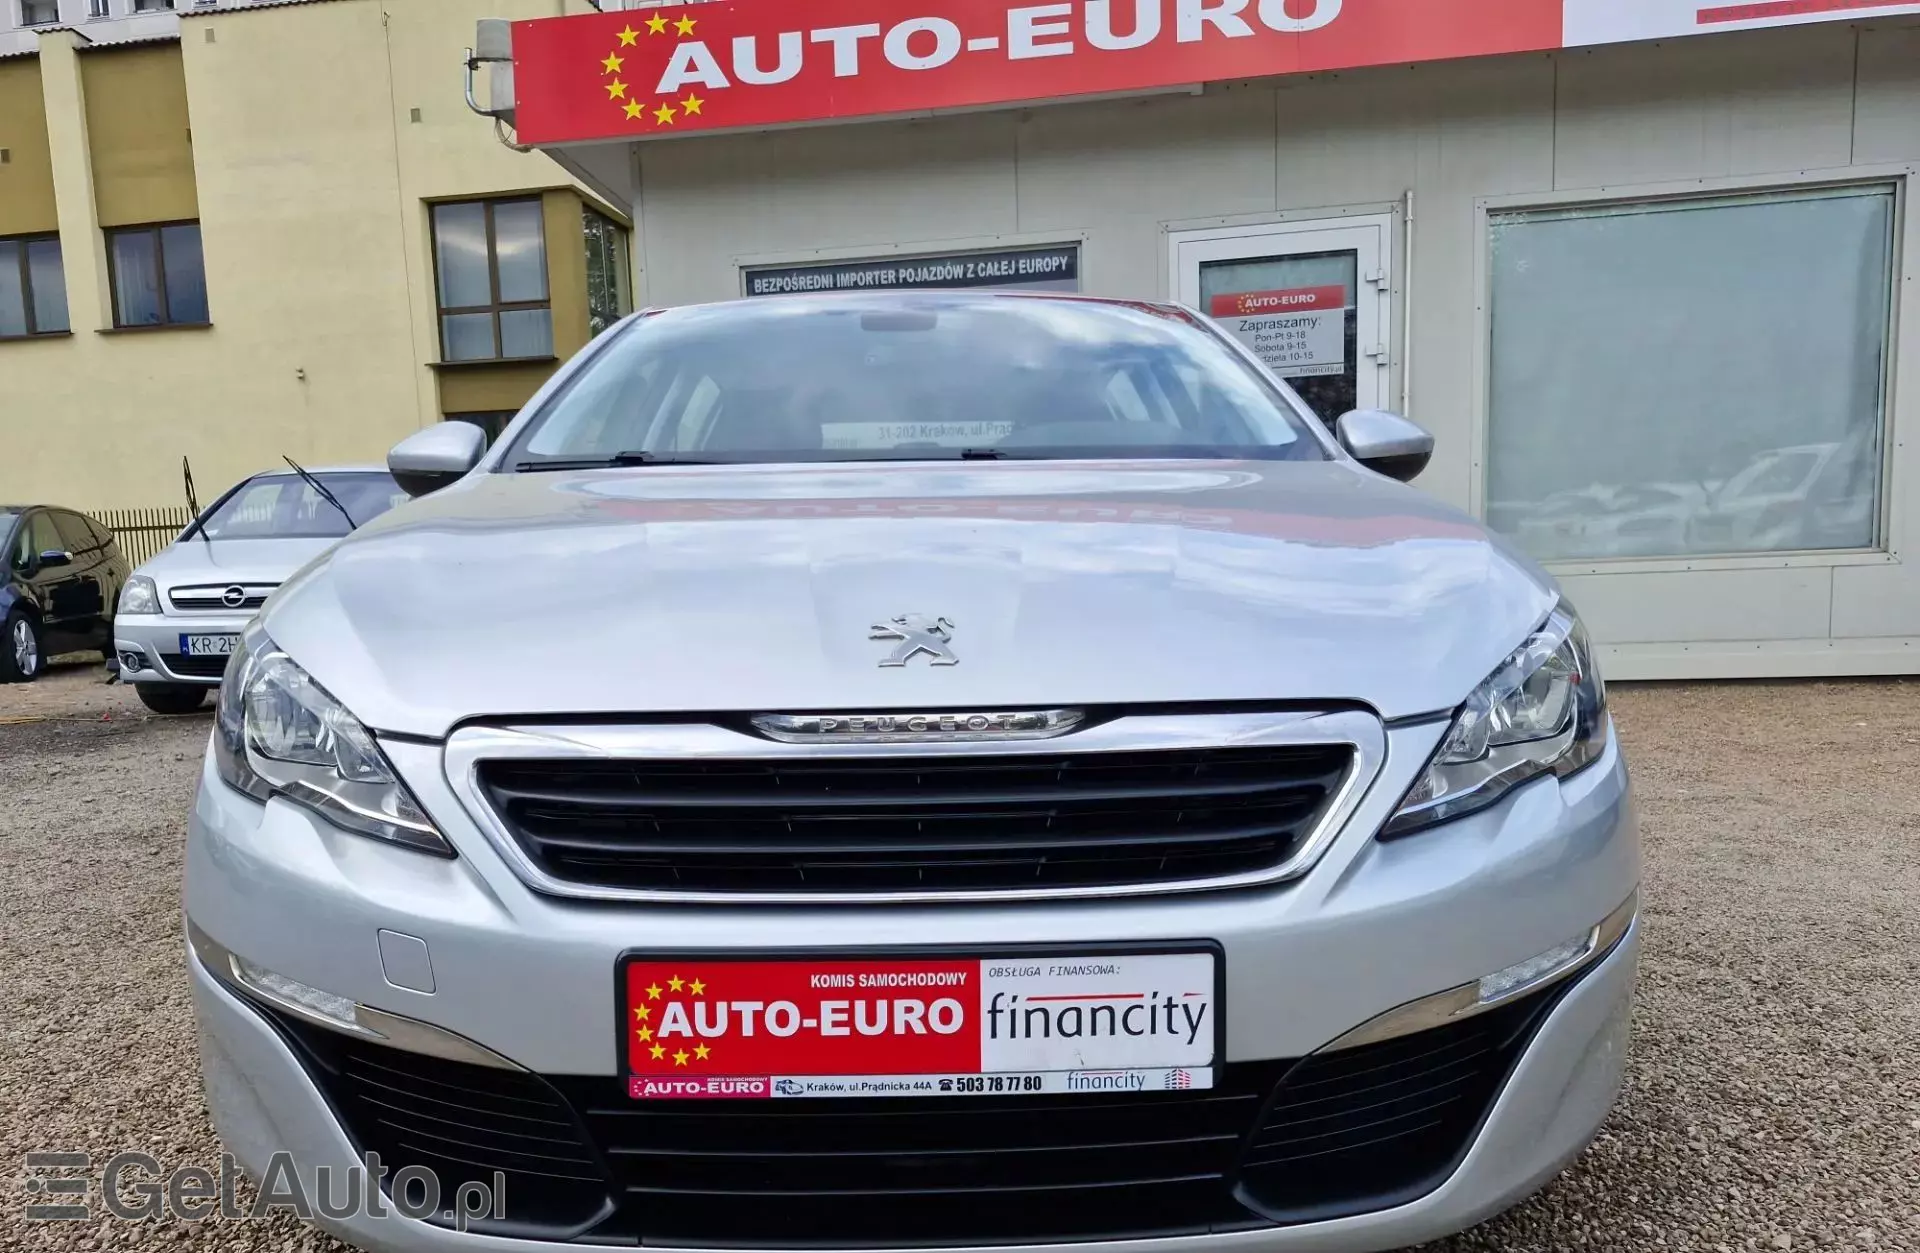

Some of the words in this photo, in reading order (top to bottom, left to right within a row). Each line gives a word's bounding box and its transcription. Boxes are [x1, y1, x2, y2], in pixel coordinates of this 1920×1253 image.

[655, 0, 1342, 94] AUTO-EURO
[754, 272, 833, 293] BEZPOŚREDNI
[836, 269, 896, 288] IMPORTER
[898, 262, 964, 284] POJAZDÓW
[966, 262, 975, 278] Z
[977, 259, 1016, 278] CAŁEJ
[1019, 255, 1068, 274] EUROPY
[1245, 294, 1315, 308] AUTO-EURO
[1239, 317, 1321, 334] Zapraszamy:
[1255, 333, 1284, 342] Pon-Pt
[1286, 331, 1306, 340] 9-18
[1254, 344, 1285, 353] Sobota
[1287, 342, 1307, 351] 9-15
[1289, 352, 1314, 361] 10-15
[191, 637, 212, 653] KR
[819, 713, 1016, 733] PEUGEOT
[988, 966, 1041, 977] OBSŁUGA
[1048, 965, 1121, 976] FINANSOWA:
[811, 974, 854, 988] KOMIS
[858, 972, 967, 988] SAMOCHODOWY
[657, 997, 964, 1038] AUTO-EURO
[987, 991, 1207, 1045] financity
[644, 1081, 765, 1095] AUTO-EURO
[806, 1082, 847, 1093] Kraków,
[913, 1081, 932, 1090] 44A
[956, 1077, 984, 1092] 503
[987, 1077, 1003, 1091] 78
[1006, 1077, 1022, 1091] 77
[1023, 1076, 1042, 1091] 80
[1067, 1072, 1146, 1091] financity
